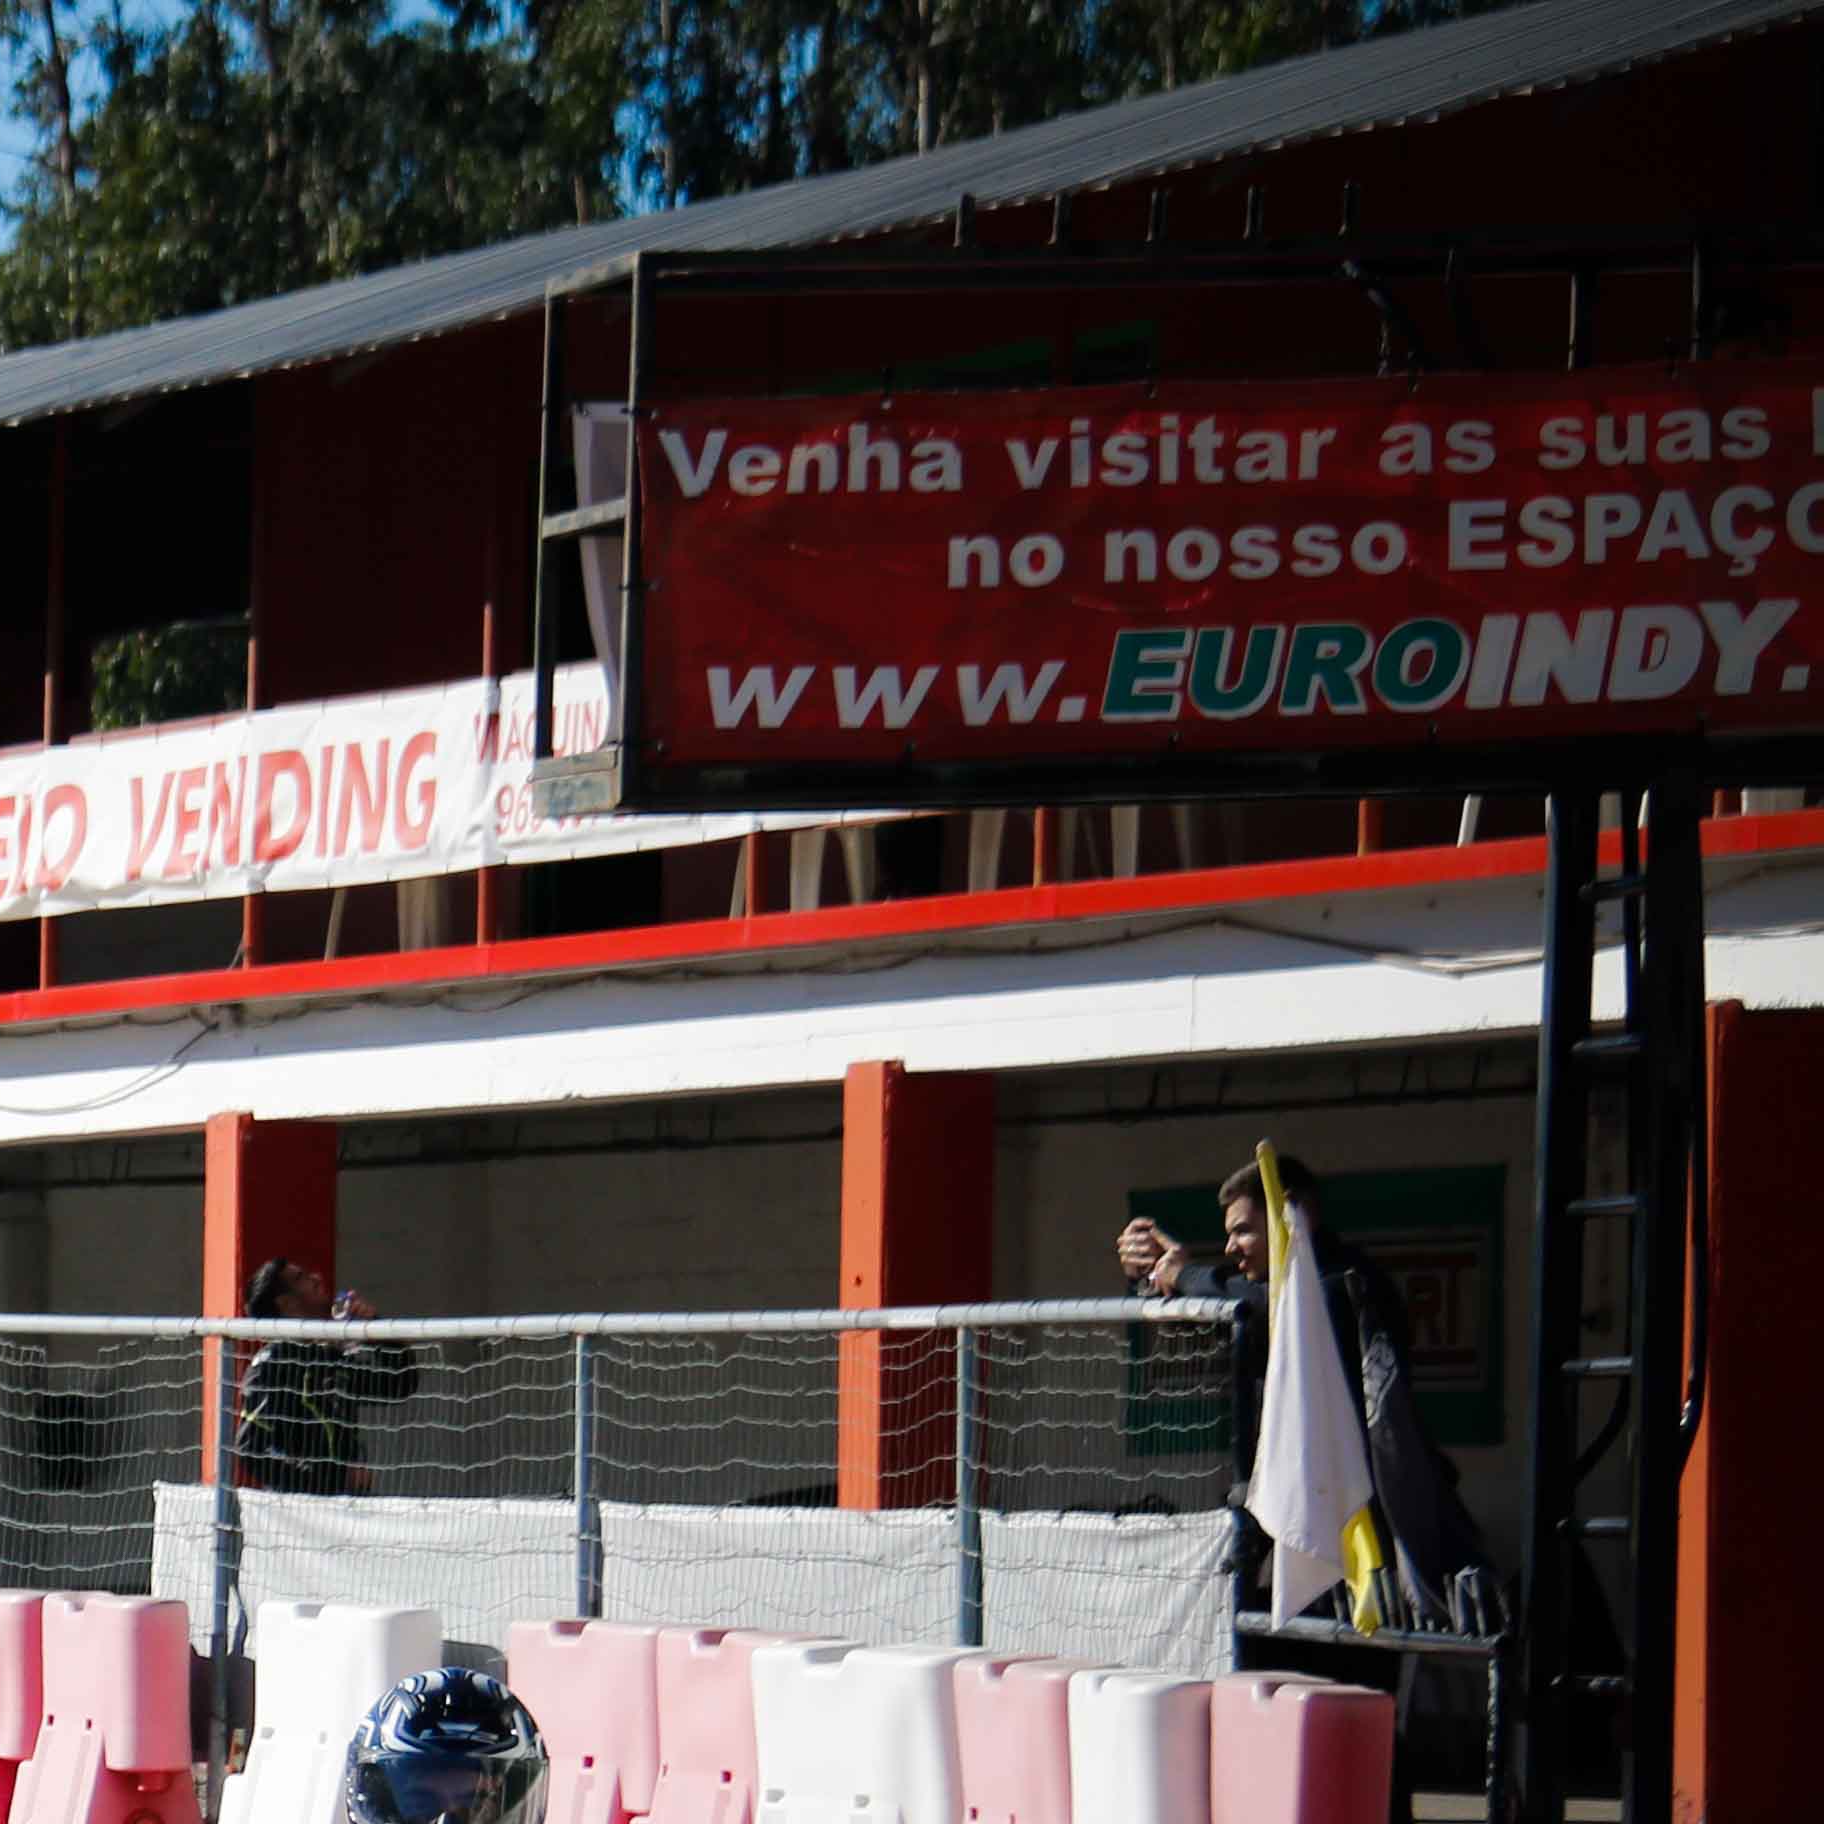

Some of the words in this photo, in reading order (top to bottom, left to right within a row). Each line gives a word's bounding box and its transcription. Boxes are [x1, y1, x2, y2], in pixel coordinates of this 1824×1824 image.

[659, 423, 963, 498] Venha
[1007, 414, 1337, 490] visitar
[1378, 419, 1496, 475] as
[1537, 404, 1772, 470] suas
[948, 532, 1065, 589] no
[1104, 520, 1407, 583] nosso
[127, 729, 438, 883] VENDING
